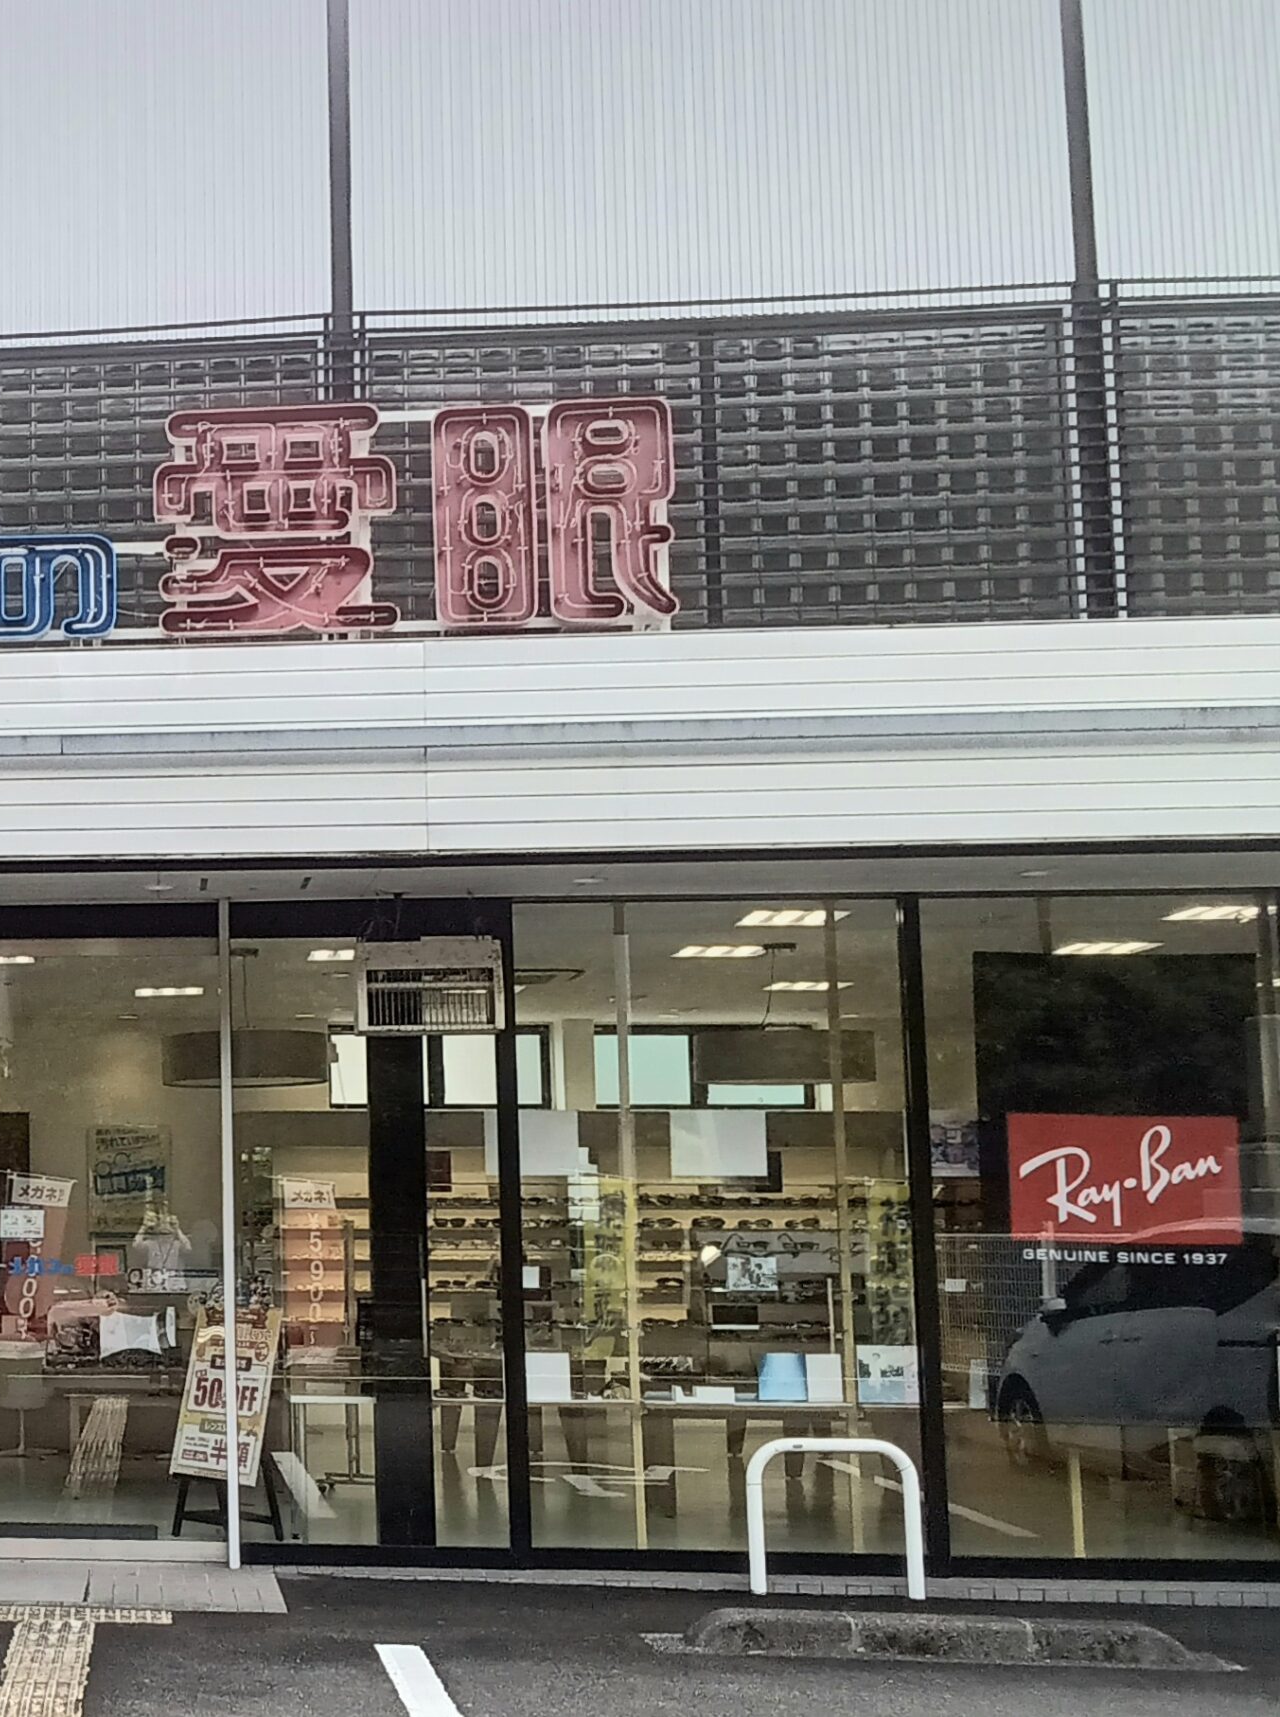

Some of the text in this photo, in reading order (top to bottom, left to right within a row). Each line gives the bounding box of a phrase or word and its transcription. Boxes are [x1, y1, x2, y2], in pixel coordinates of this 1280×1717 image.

[1022, 1248, 1228, 1265] GENUINE SINCE 1937
